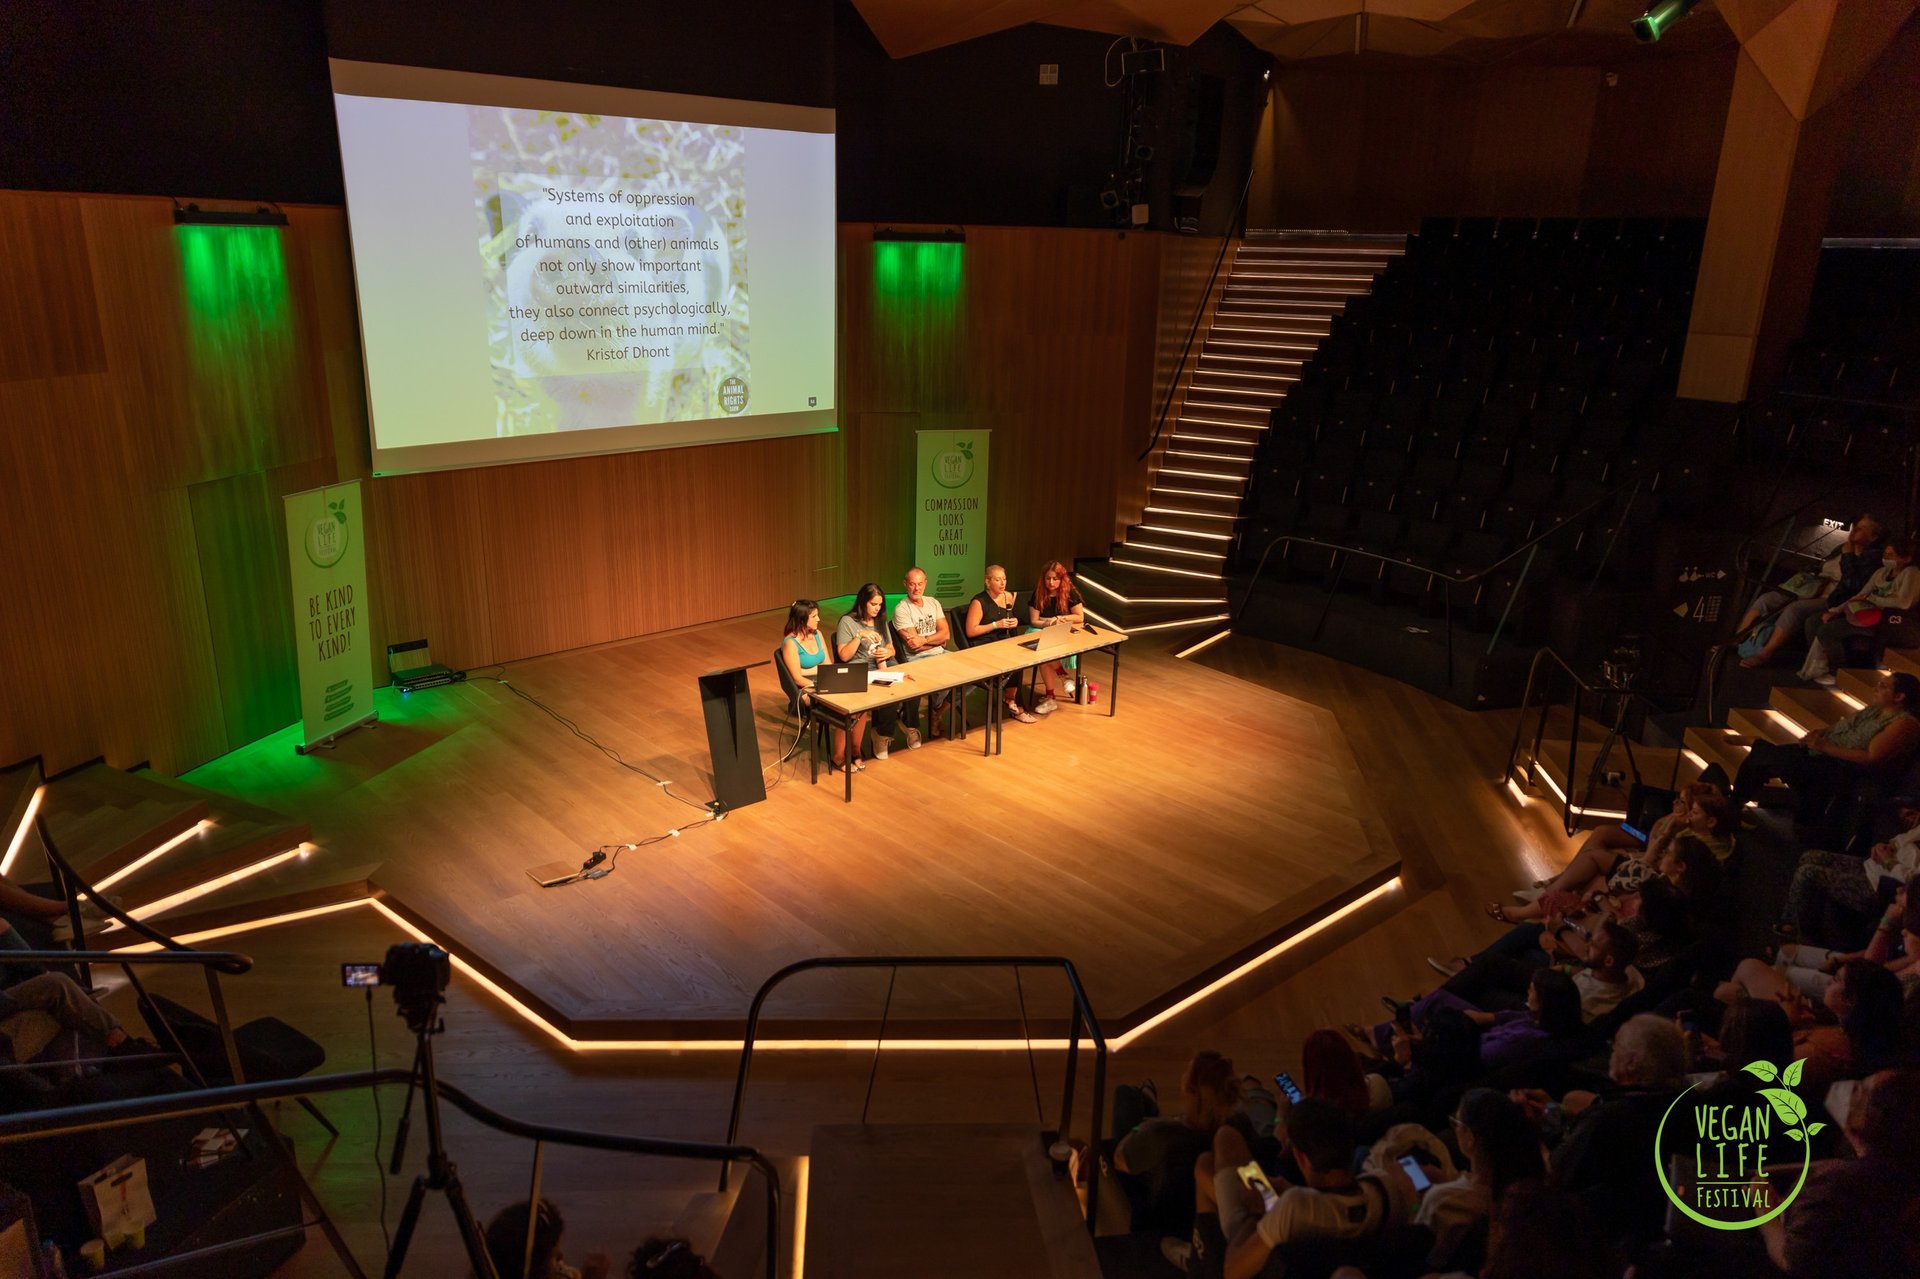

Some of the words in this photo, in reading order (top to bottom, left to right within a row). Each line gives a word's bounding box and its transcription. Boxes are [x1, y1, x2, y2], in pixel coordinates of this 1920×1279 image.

[543, 188, 604, 205] "Systems
[609, 190, 622, 203] of
[627, 193, 694, 206] oppression
[566, 213, 592, 226] and
[597, 215, 674, 229] exploitation
[516, 236, 531, 248] of
[535, 236, 590, 248] humans
[595, 236, 620, 249] and
[625, 236, 666, 251] (other)
[671, 238, 718, 250] animals
[540, 261, 563, 272] not
[568, 259, 596, 275] only
[602, 259, 634, 271] show
[639, 259, 701, 274] important
[556, 282, 613, 295] outward
[618, 281, 689, 294] similarities,
[509, 306, 540, 321] they
[545, 305, 574, 317] also
[579, 305, 629, 317] connect
[634, 302, 730, 318] psychologically,
[521, 329, 554, 343] deep
[560, 327, 596, 340] down
[601, 327, 612, 338] in
[616, 325, 636, 337] the
[641, 324, 683, 336] human
[688, 323, 724, 335] mind."
[587, 347, 628, 360] Kristof
[634, 346, 669, 359] Dhont
[723, 385, 744, 394] ANIMAL
[724, 395, 744, 405] RIGHTS
[925, 497, 979, 511] COMPASSION
[939, 513, 964, 526] LOOKS
[1823, 518, 1844, 530] EXIT
[939, 529, 963, 541] GREAT
[934, 544, 945, 556] ON
[949, 544, 968, 555] YOU!
[309, 596, 321, 618] BE
[325, 584, 353, 612] KIND
[1692, 595, 1705, 623] 4
[309, 619, 322, 641] TO
[327, 606, 356, 636] EVERY
[318, 631, 351, 663] KIND!
